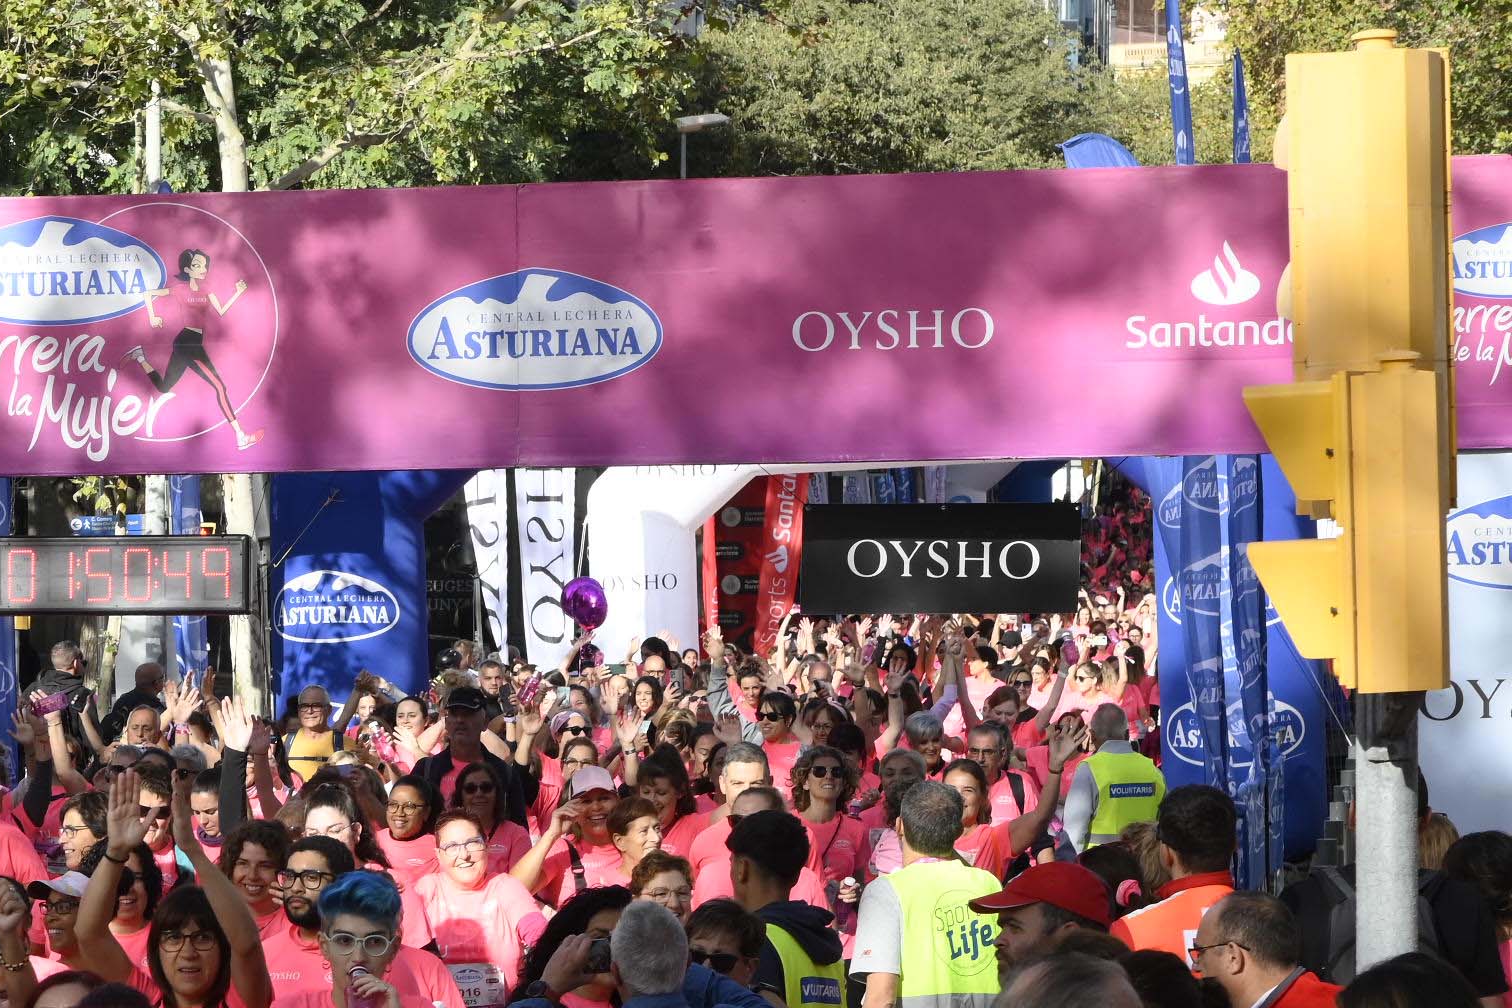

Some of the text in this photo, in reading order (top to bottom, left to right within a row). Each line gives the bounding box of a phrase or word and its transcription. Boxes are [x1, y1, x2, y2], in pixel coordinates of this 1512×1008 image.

[554, 309, 634, 321] LECHERA
[792, 307, 995, 352] OYSHO
[1125, 315, 1294, 348] Santand
[427, 317, 643, 360] ASTURIANA
[7, 377, 33, 417] la
[28, 366, 177, 462] Mujer
[847, 539, 1041, 580] OYSHO
[277, 603, 390, 626] ASTURIANA
[290, 594, 385, 604] CENTRAL LECHERA
[1110, 786, 1152, 795] VOLUNTARIS
[945, 920, 995, 960] Life
